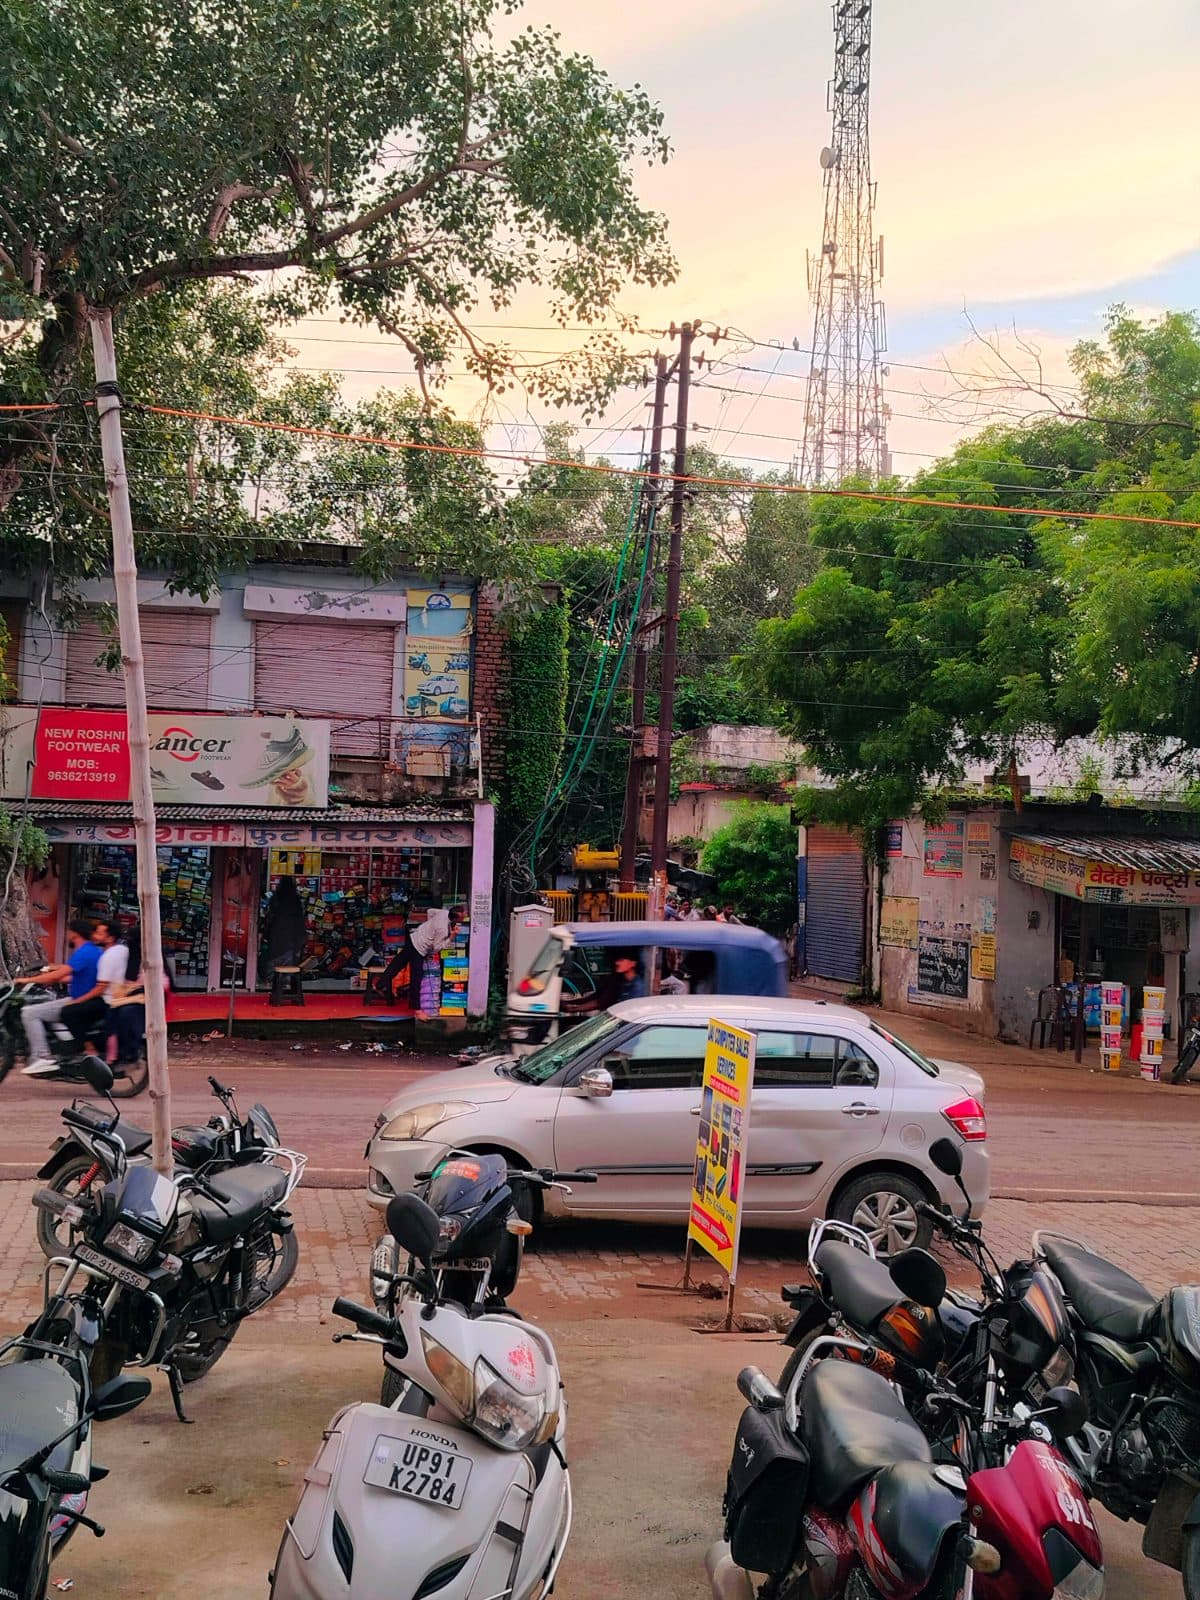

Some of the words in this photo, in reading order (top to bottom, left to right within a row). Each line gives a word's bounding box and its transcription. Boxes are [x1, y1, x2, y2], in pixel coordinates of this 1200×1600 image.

[45, 728, 74, 739] NEW
[77, 729, 125, 741] ROSHNI
[48, 741, 120, 753] FOOTWEAR
[67, 758, 99, 770] MOB:
[47, 771, 116, 783] 9636213919
[736, 1037, 749, 1059] SALES
[86, 1252, 98, 1262] UP
[410, 1428, 459, 1451] HONDA
[402, 1444, 455, 1478] UP91
[388, 1465, 456, 1505] K2784
